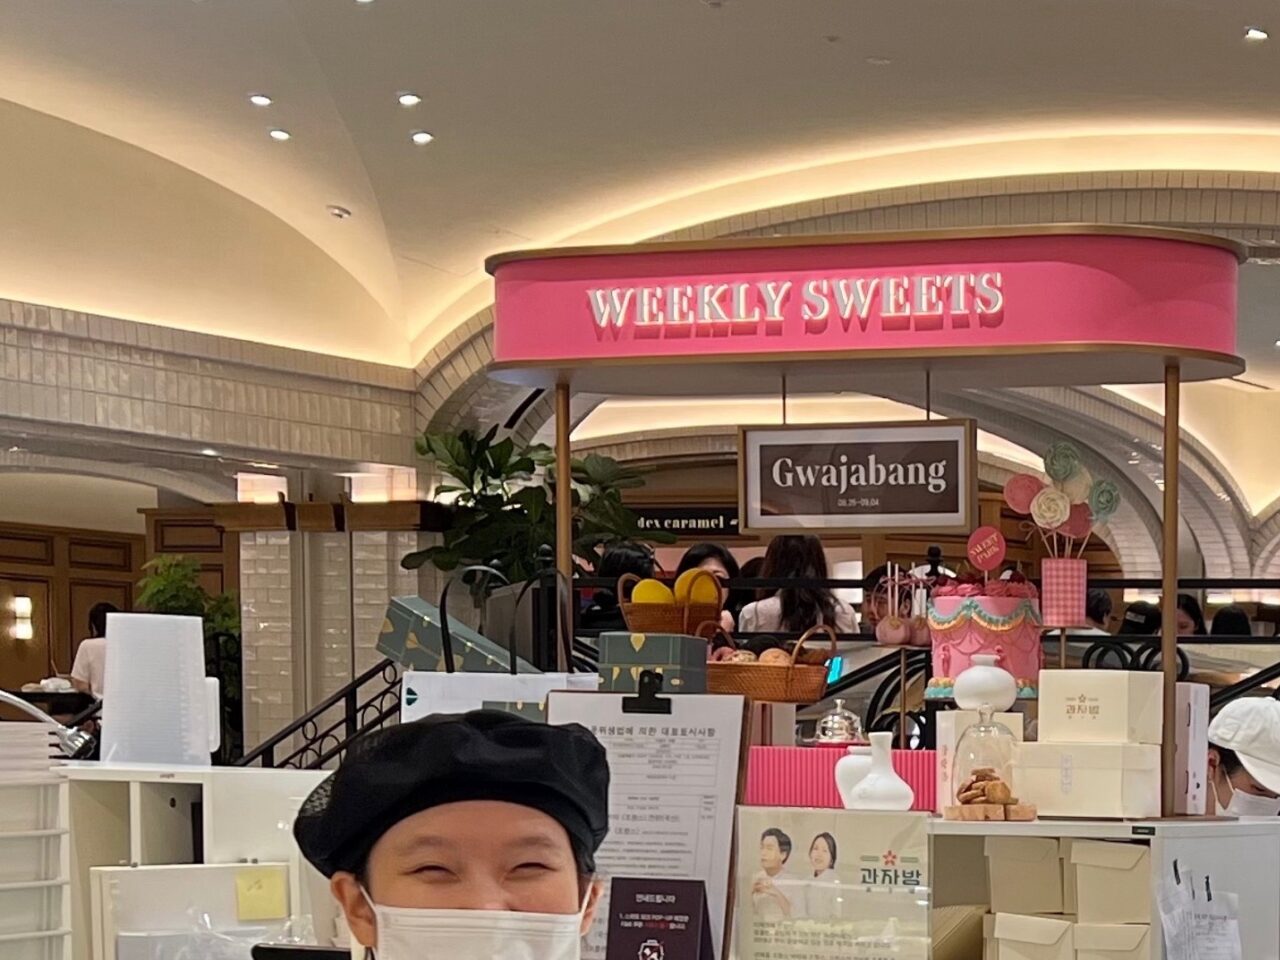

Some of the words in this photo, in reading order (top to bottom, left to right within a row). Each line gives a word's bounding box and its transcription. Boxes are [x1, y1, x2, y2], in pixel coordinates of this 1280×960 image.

[587, 280, 793, 327] WEEKLY
[801, 271, 1004, 320] SWEETS
[772, 454, 947, 494] Gwajabang
[663, 515, 724, 529] caramel
[860, 868, 922, 886] 과자방
